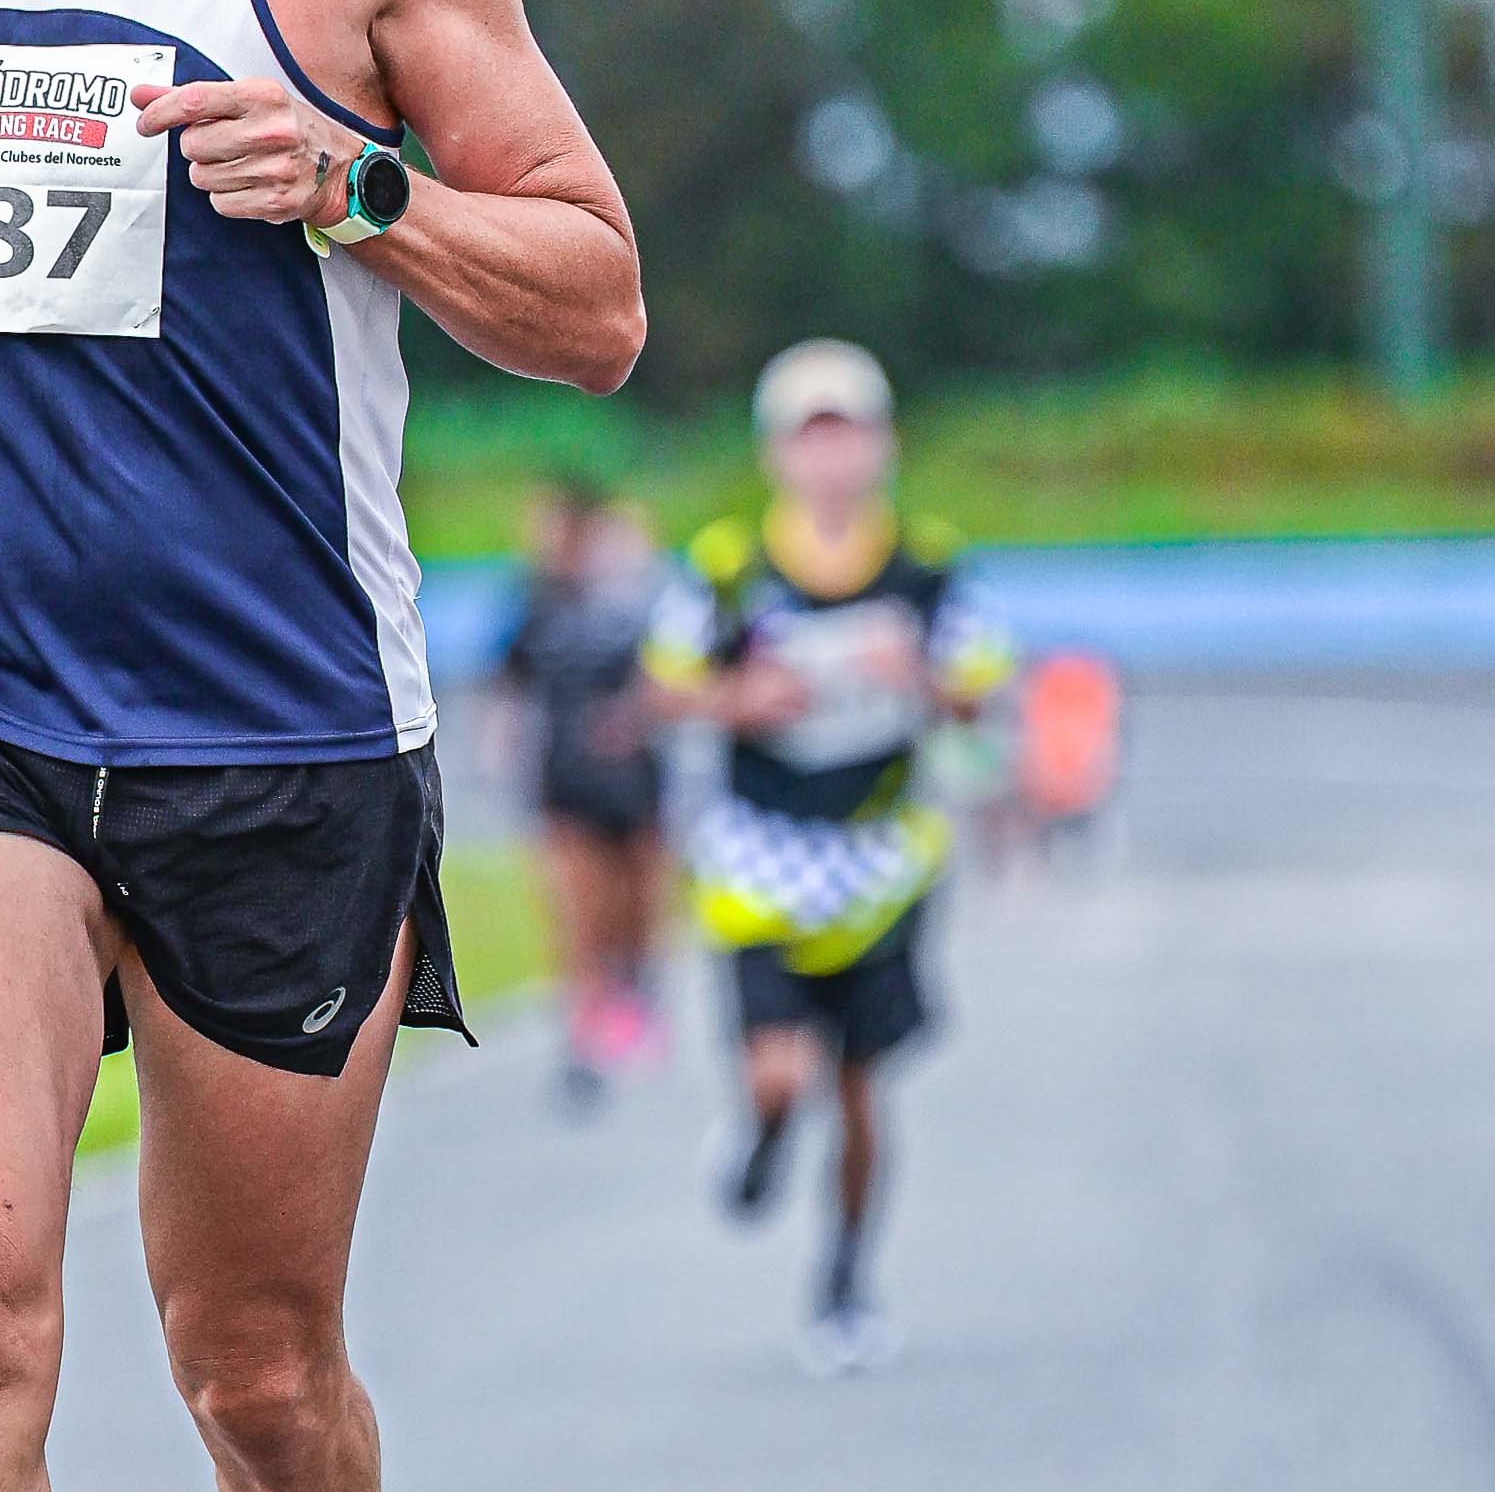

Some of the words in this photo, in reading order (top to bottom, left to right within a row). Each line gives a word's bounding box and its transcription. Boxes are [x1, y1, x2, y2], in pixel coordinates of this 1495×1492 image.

[32, 116, 85, 143] RACE
[0, 150, 41, 163] Clubes
[44, 151, 64, 164] del
[66, 152, 122, 166] Noroeste
